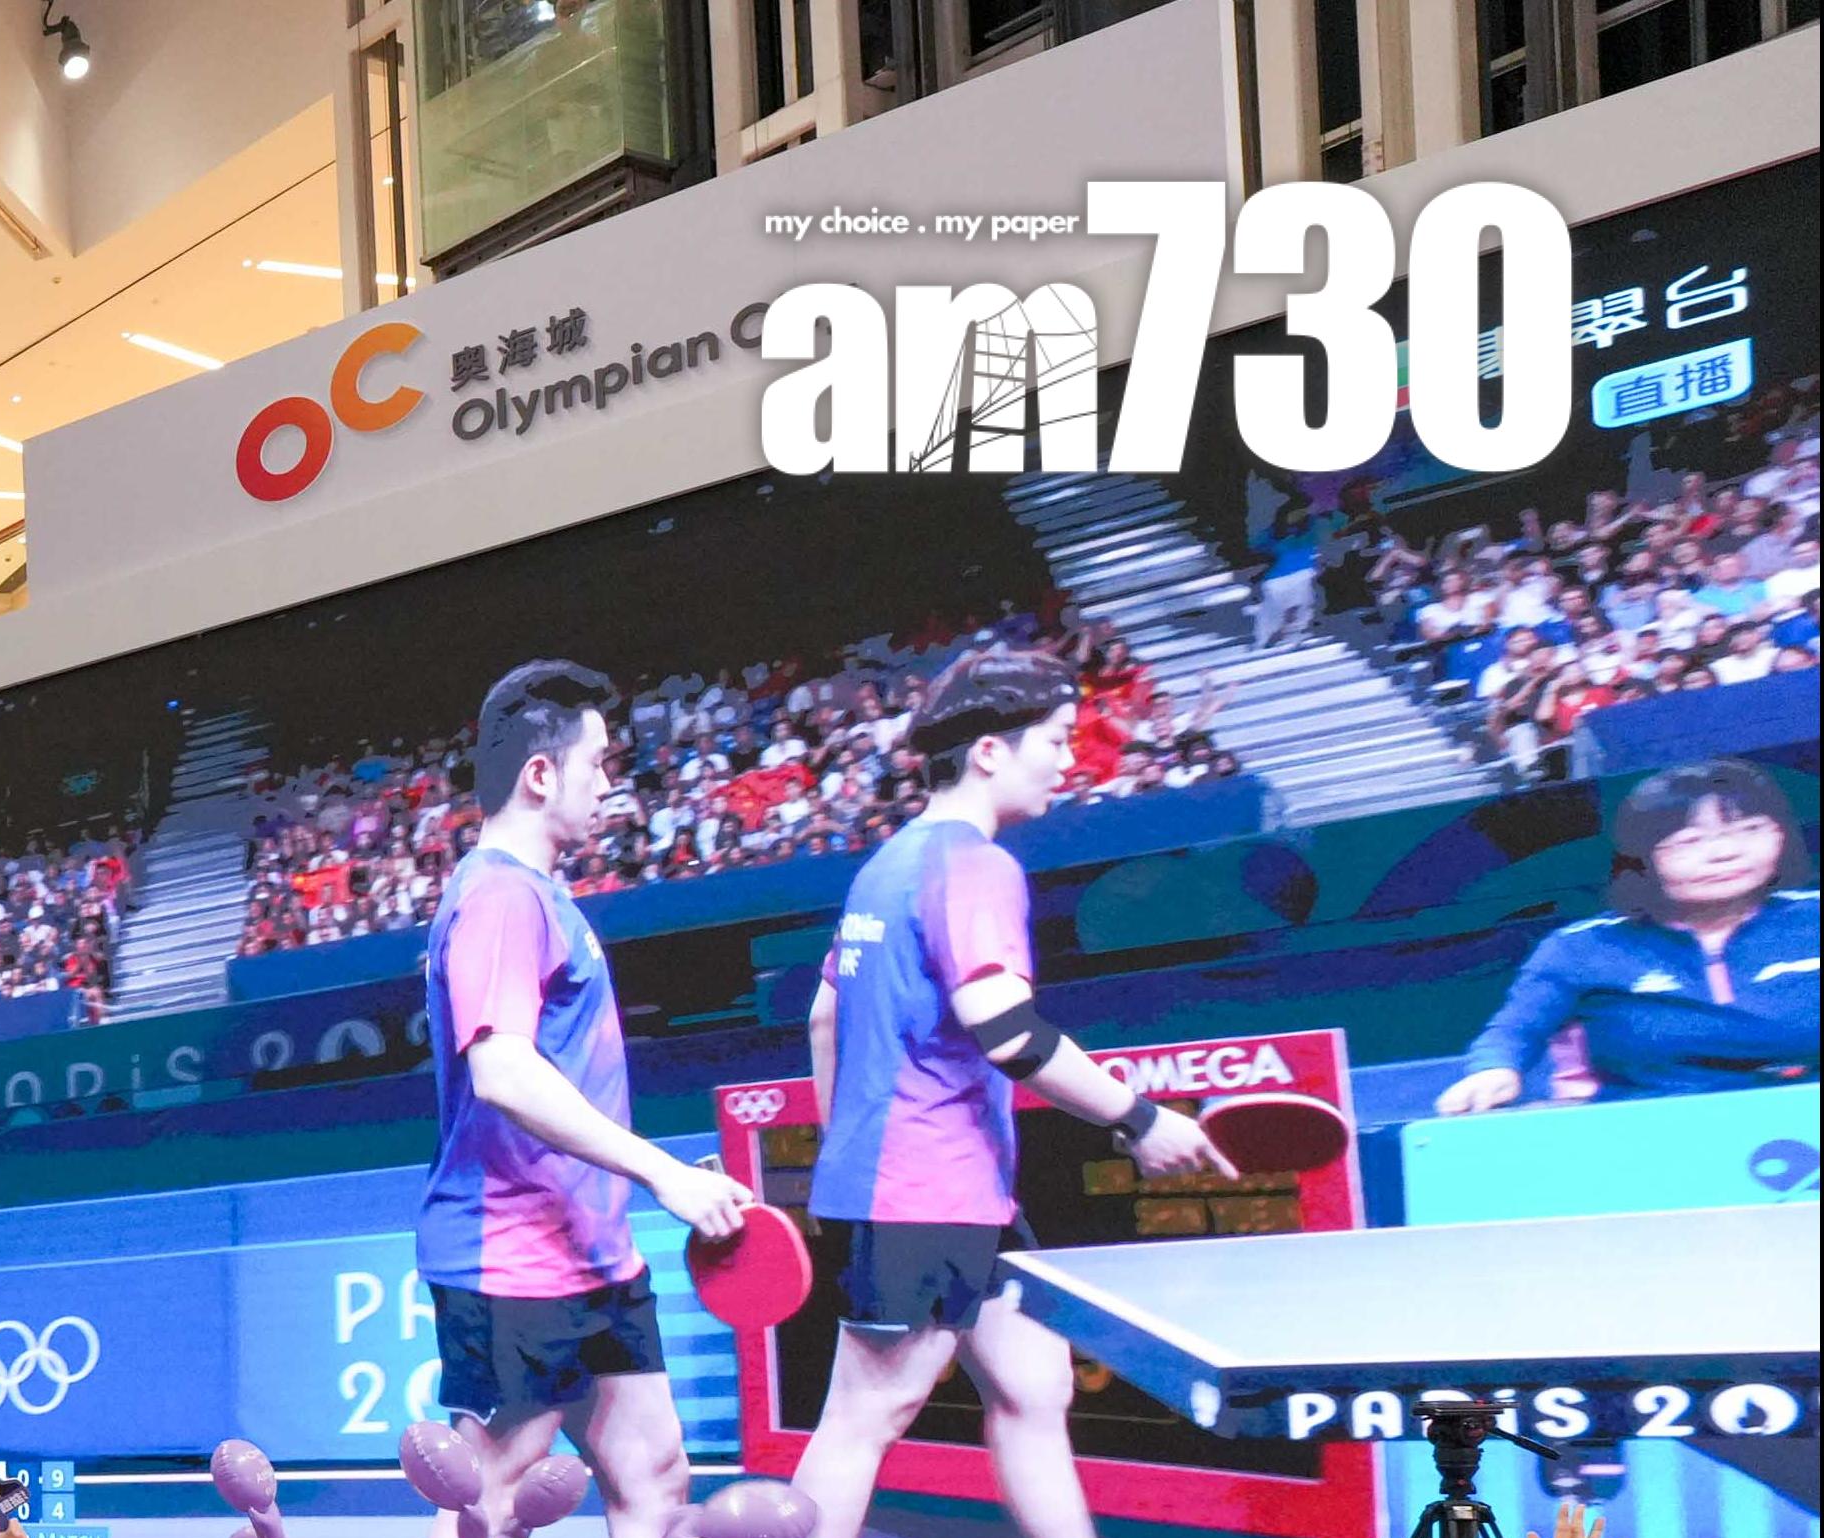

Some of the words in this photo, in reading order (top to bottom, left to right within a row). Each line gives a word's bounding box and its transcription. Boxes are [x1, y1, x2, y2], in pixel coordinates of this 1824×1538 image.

[449, 306, 591, 393] 奧海城
[235, 321, 426, 503] OC
[451, 330, 721, 442] Olympian
[1609, 351, 1735, 421] 直播
[1103, 1044, 1294, 1095] OMEGA
[51, 1470, 64, 1488] 9
[51, 1502, 65, 1520] 4
